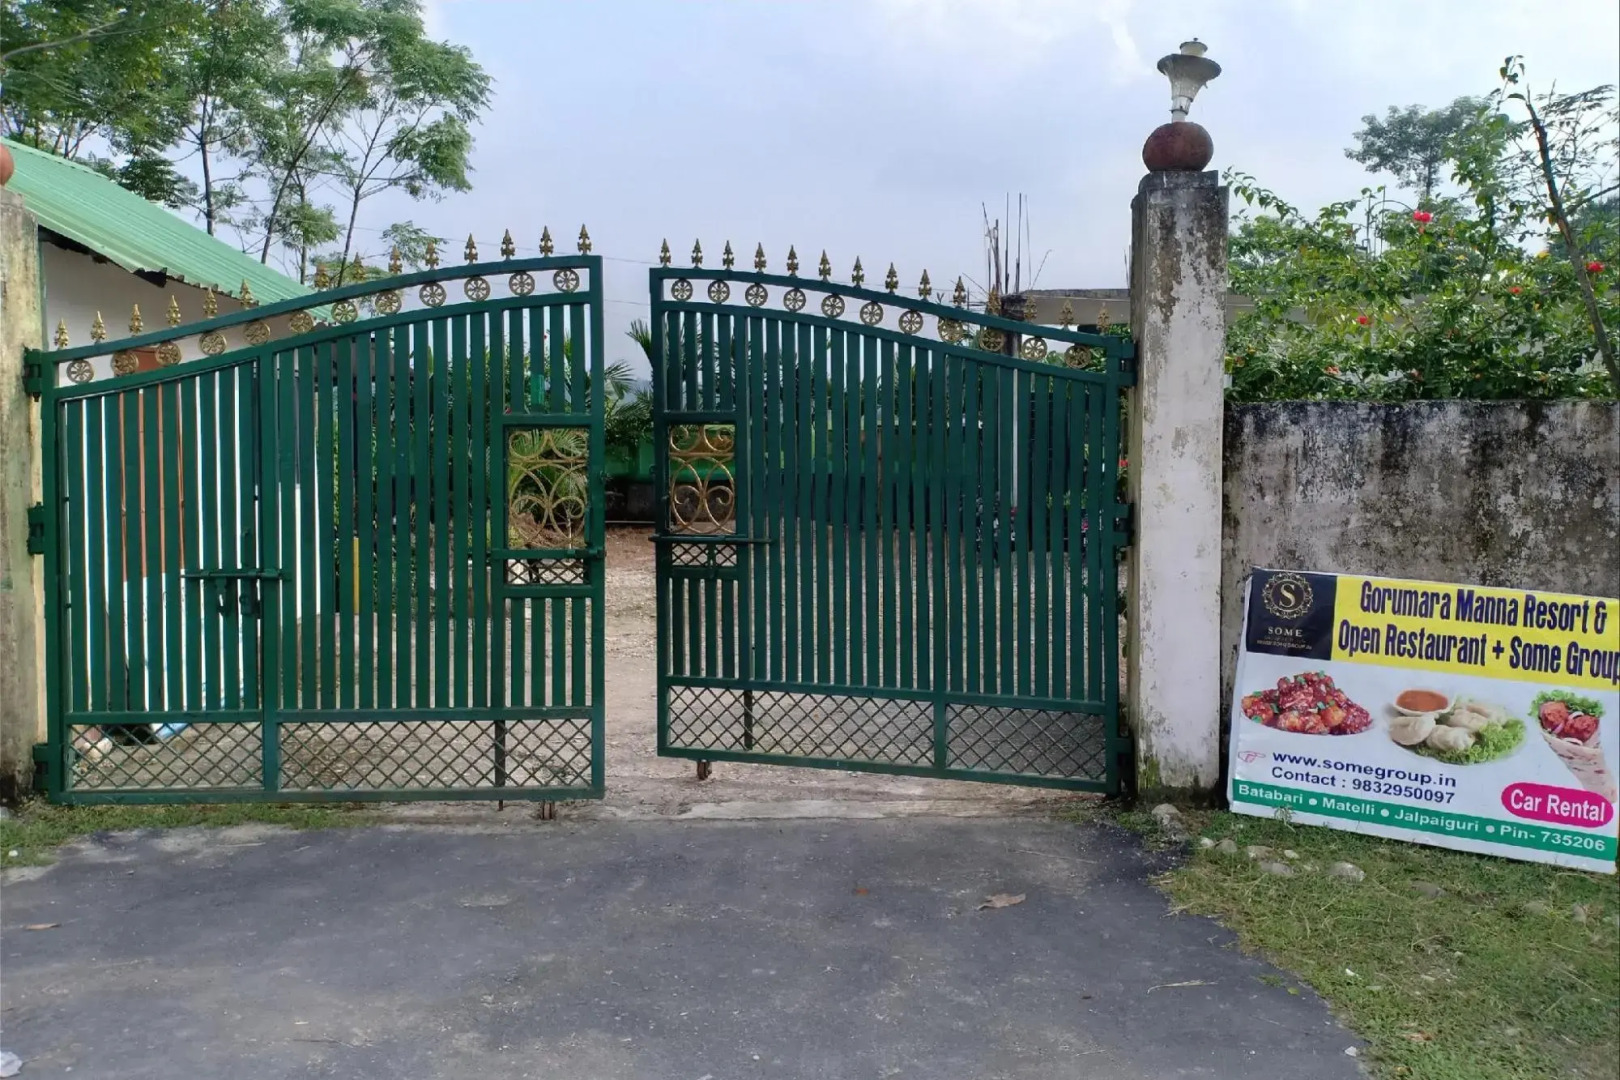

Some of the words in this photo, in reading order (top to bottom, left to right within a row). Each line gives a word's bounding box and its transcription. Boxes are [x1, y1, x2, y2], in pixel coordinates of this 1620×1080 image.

[1360, 580, 1450, 620] Gorumara
[1455, 588, 1518, 625] Manna
[1523, 594, 1589, 633] Resort
[1593, 601, 1608, 634] &
[1267, 626, 1303, 637] SOME
[1338, 619, 1380, 656] Open
[1385, 623, 1486, 667] Restaurant
[1509, 636, 1561, 673] Some
[1271, 751, 1457, 789] www.somegroup.in
[1271, 766, 1337, 789] Contact
[1352, 778, 1455, 805] 9832950097
[1238, 784, 1303, 805] Batabari
[1322, 797, 1376, 817] Matelli
[1394, 808, 1480, 833] Jalpaiguri
[1541, 830, 1606, 852] 735206
[1510, 789, 1543, 814] Car
[1546, 794, 1606, 822] Rental
